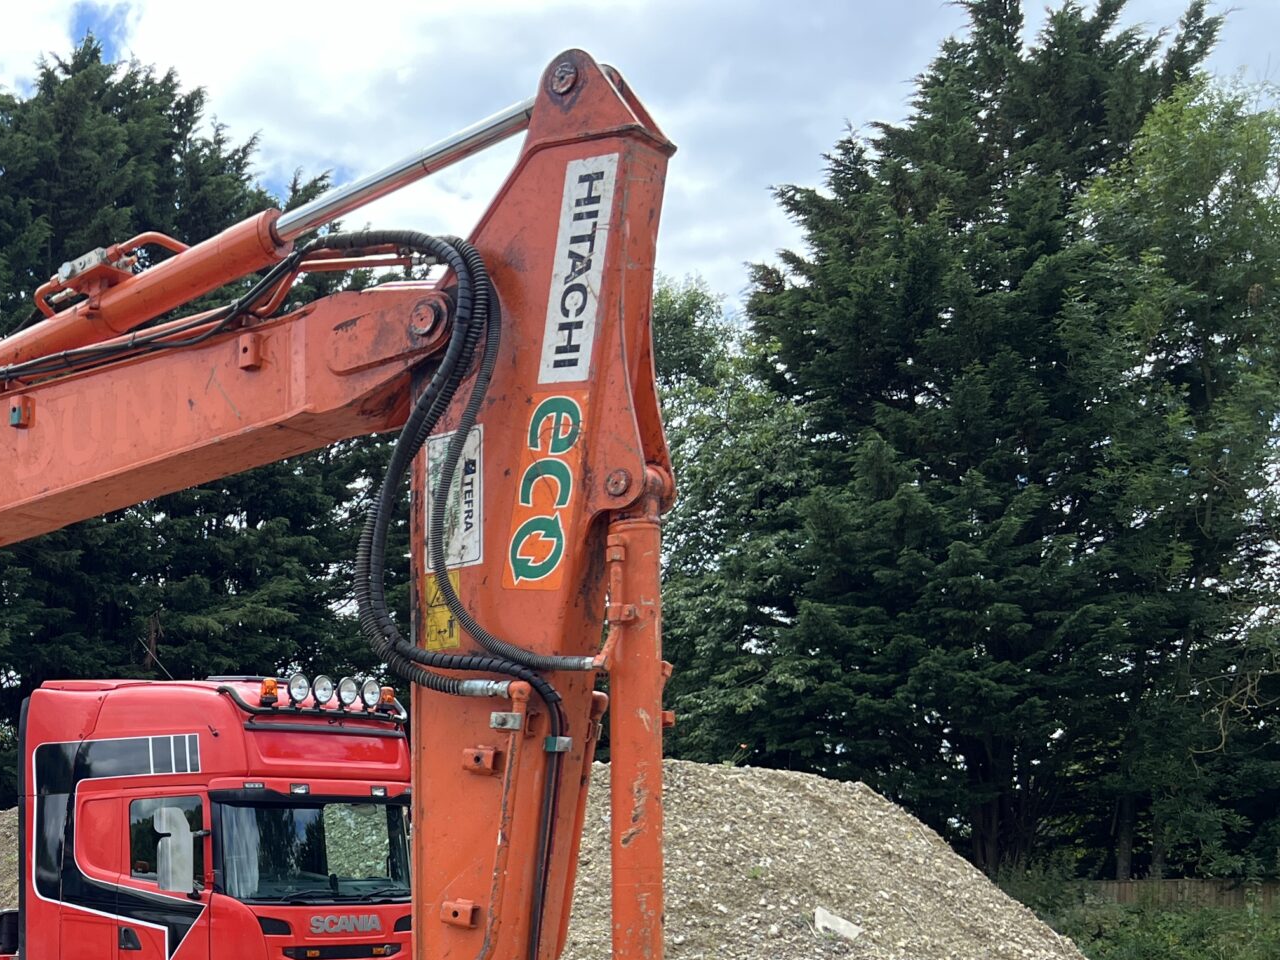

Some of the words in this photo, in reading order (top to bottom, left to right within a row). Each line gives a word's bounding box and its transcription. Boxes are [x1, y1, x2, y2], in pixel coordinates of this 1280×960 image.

[553, 170, 605, 369] HITACHI
[464, 477, 474, 533] TEFRA
[508, 396, 583, 586] eco
[310, 914, 382, 934] SCANIA
